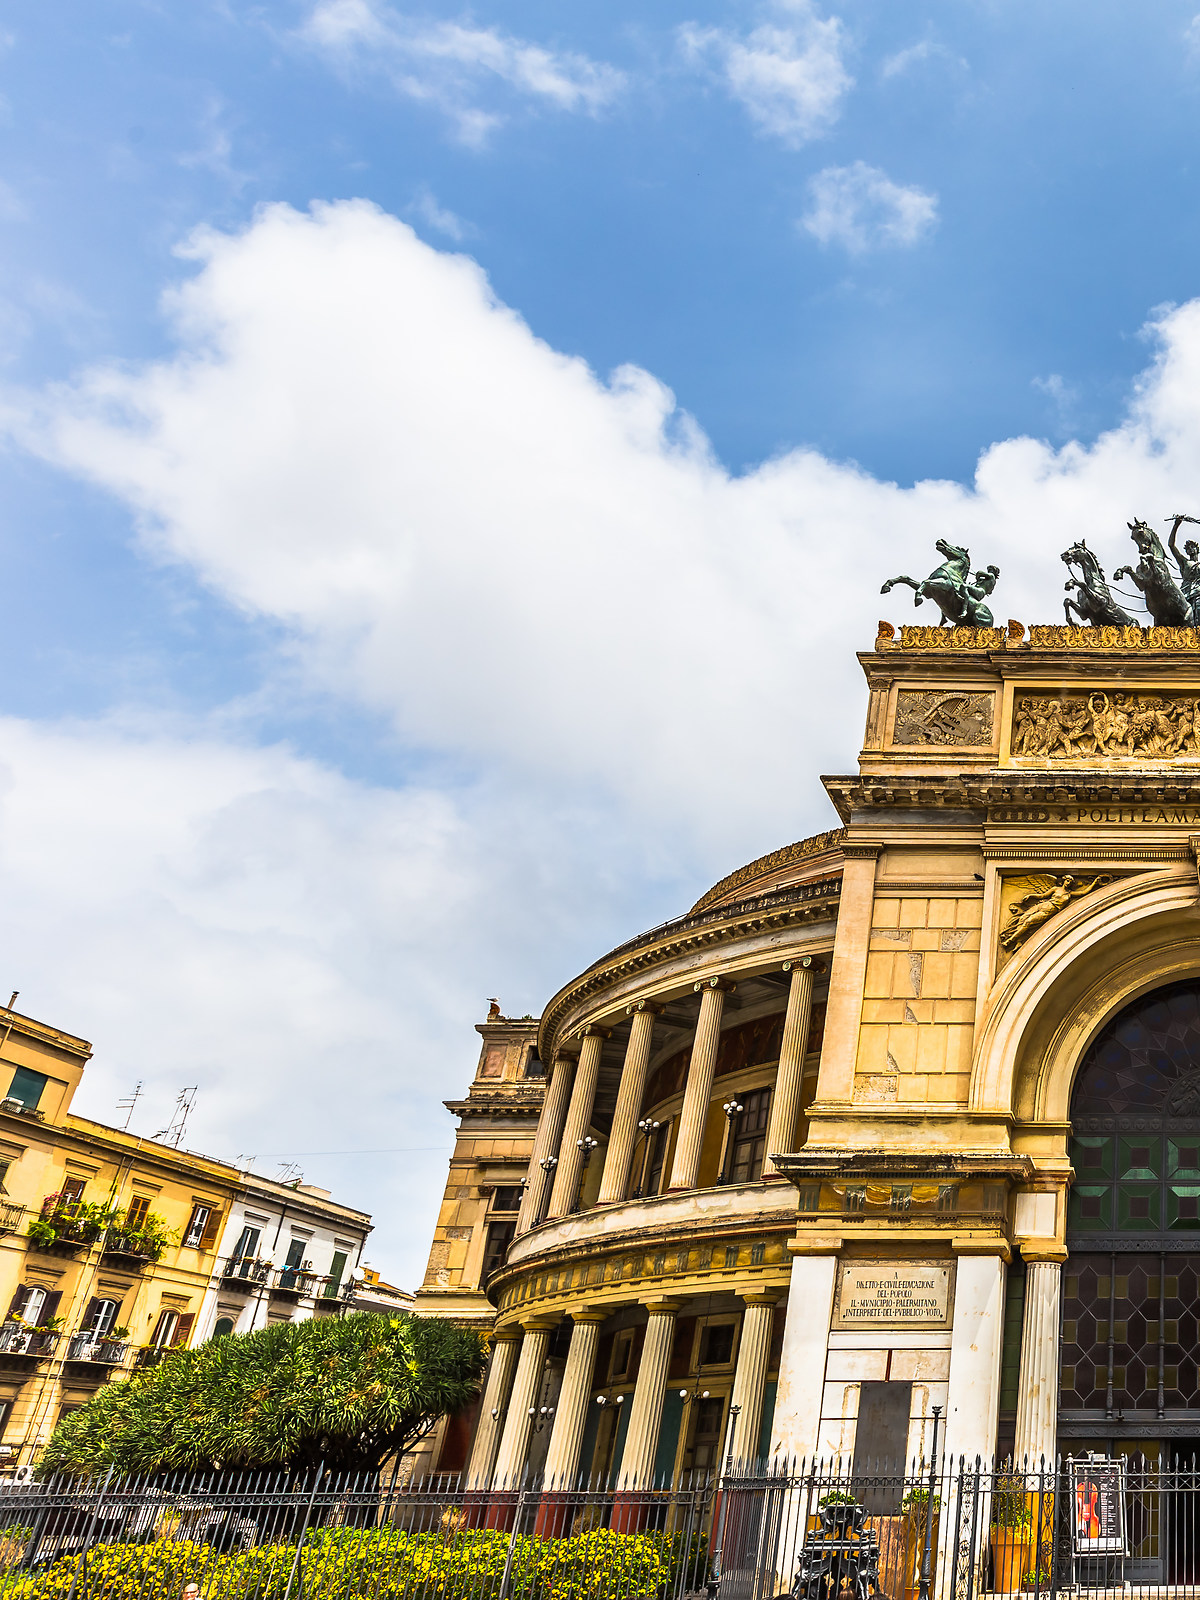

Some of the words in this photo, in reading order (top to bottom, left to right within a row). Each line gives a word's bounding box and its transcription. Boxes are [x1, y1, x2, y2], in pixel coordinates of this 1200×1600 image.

[884, 1280, 901, 1288] CIVILE
[876, 1290, 887, 1298] DEL
[890, 1290, 912, 1298] POPOLO
[850, 1299, 856, 1307] IL
[895, 1299, 937, 1307] PALERMITANO
[845, 1309, 881, 1317] INTERPRETE
[882, 1309, 892, 1317] DEL
[925, 1309, 941, 1317] VOTO
